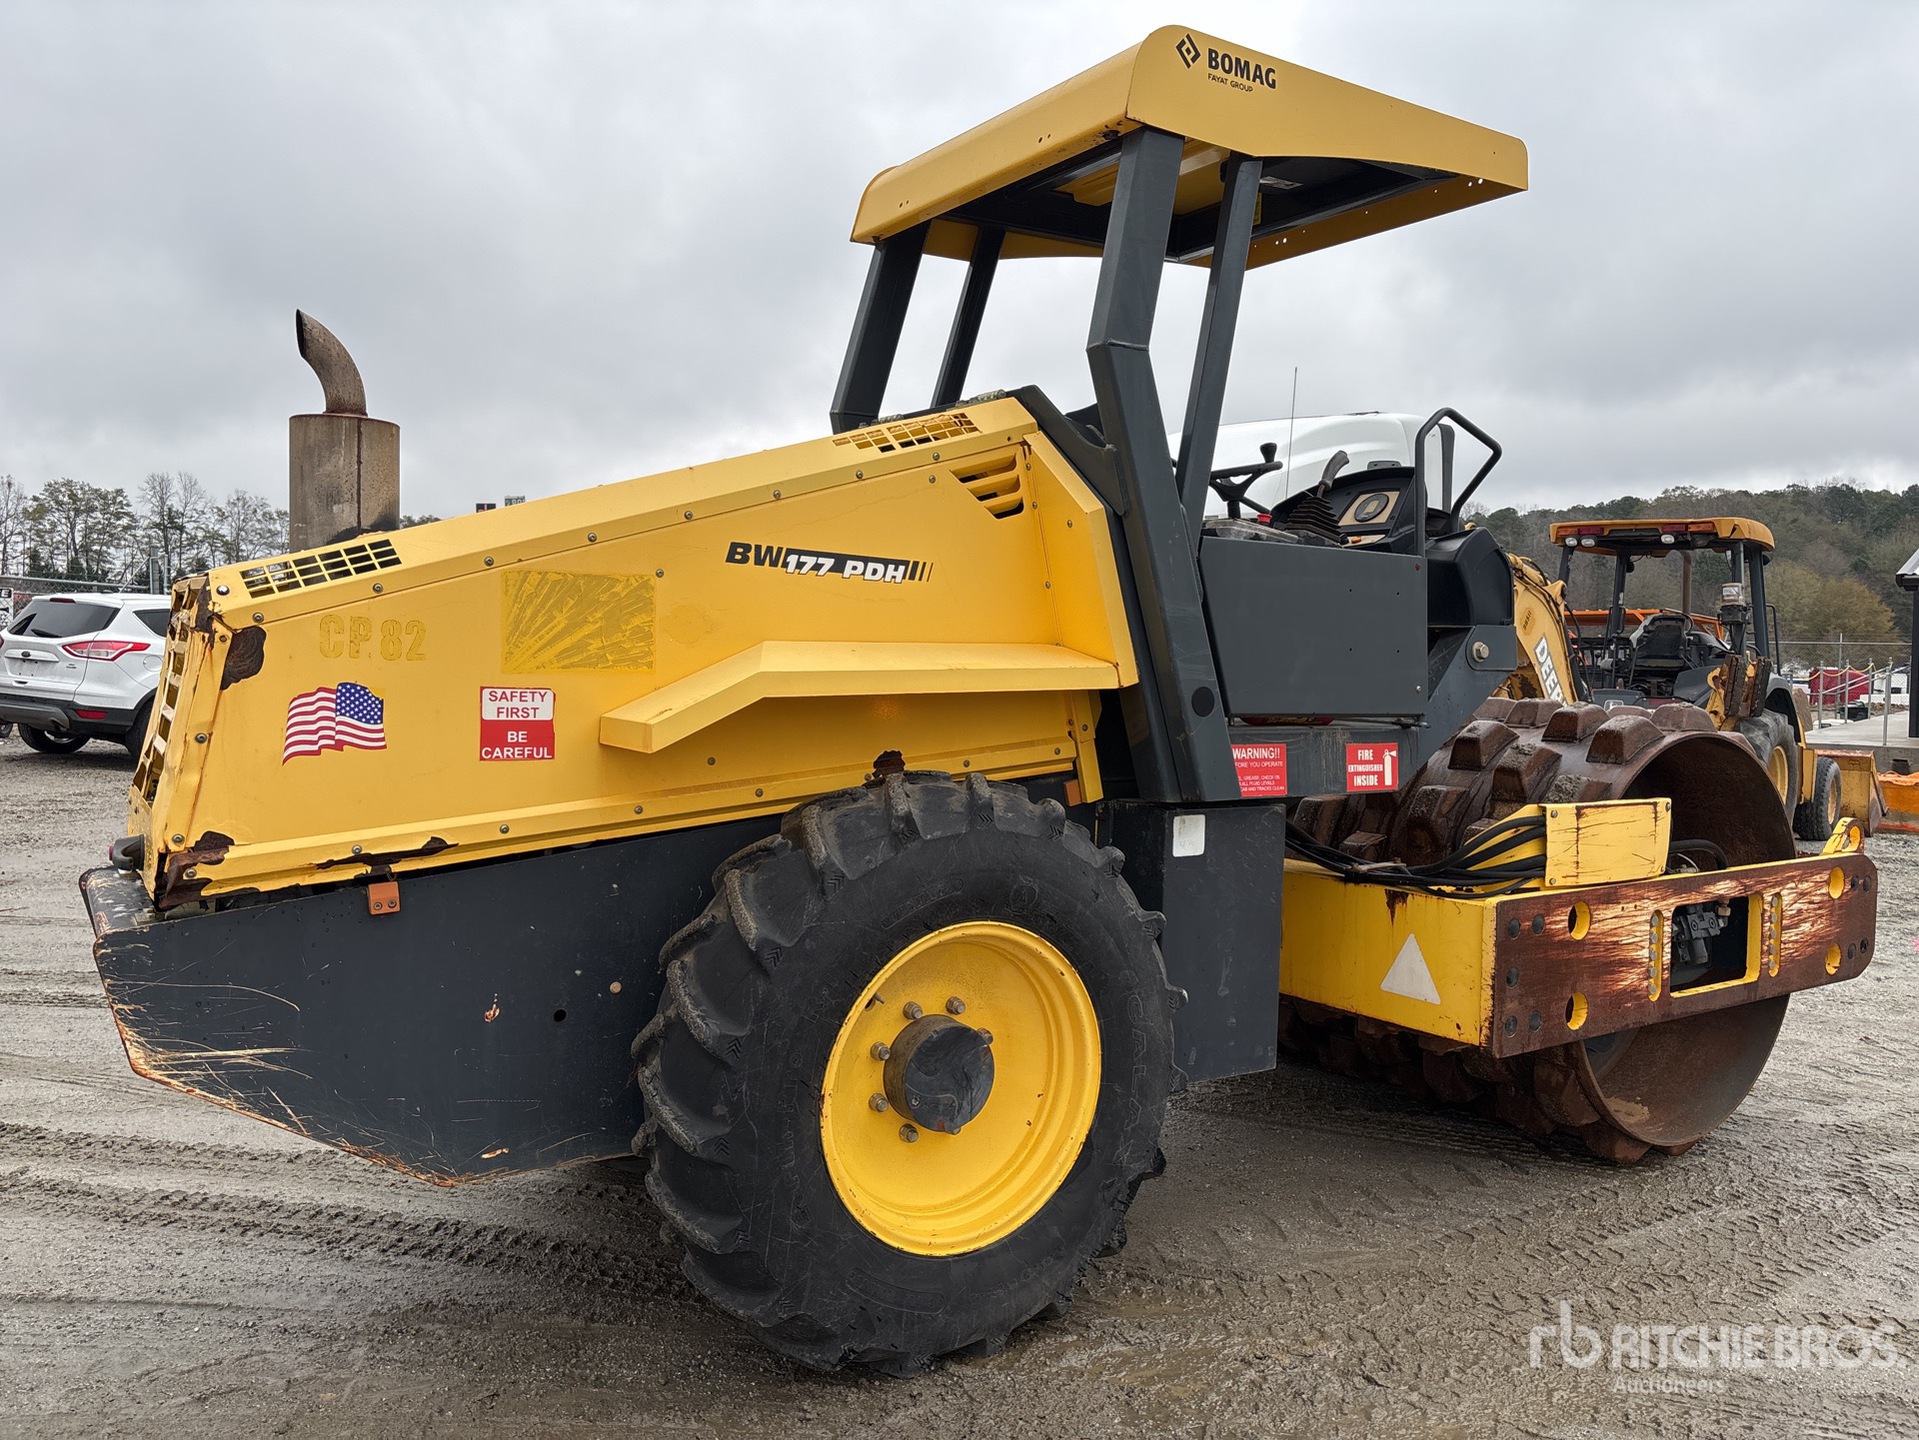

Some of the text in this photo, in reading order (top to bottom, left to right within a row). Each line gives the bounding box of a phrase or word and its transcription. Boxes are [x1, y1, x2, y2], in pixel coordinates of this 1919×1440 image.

[1208, 48, 1276, 90] BOMAG
[1208, 73, 1254, 93] FAYAT GROUP
[842, 560, 906, 584] PDH
[488, 690, 548, 703] SAFETY
[496, 706, 540, 719] FIRST
[507, 730, 528, 743] BE
[481, 746, 553, 759] CAREFUL
[1232, 747, 1280, 759] WARNING!!
[1357, 749, 1374, 761] FIRE
[1260, 760, 1284, 768] OPERATE
[1348, 763, 1384, 773] EXTINGUISHER
[1353, 774, 1379, 787] INSIDE
